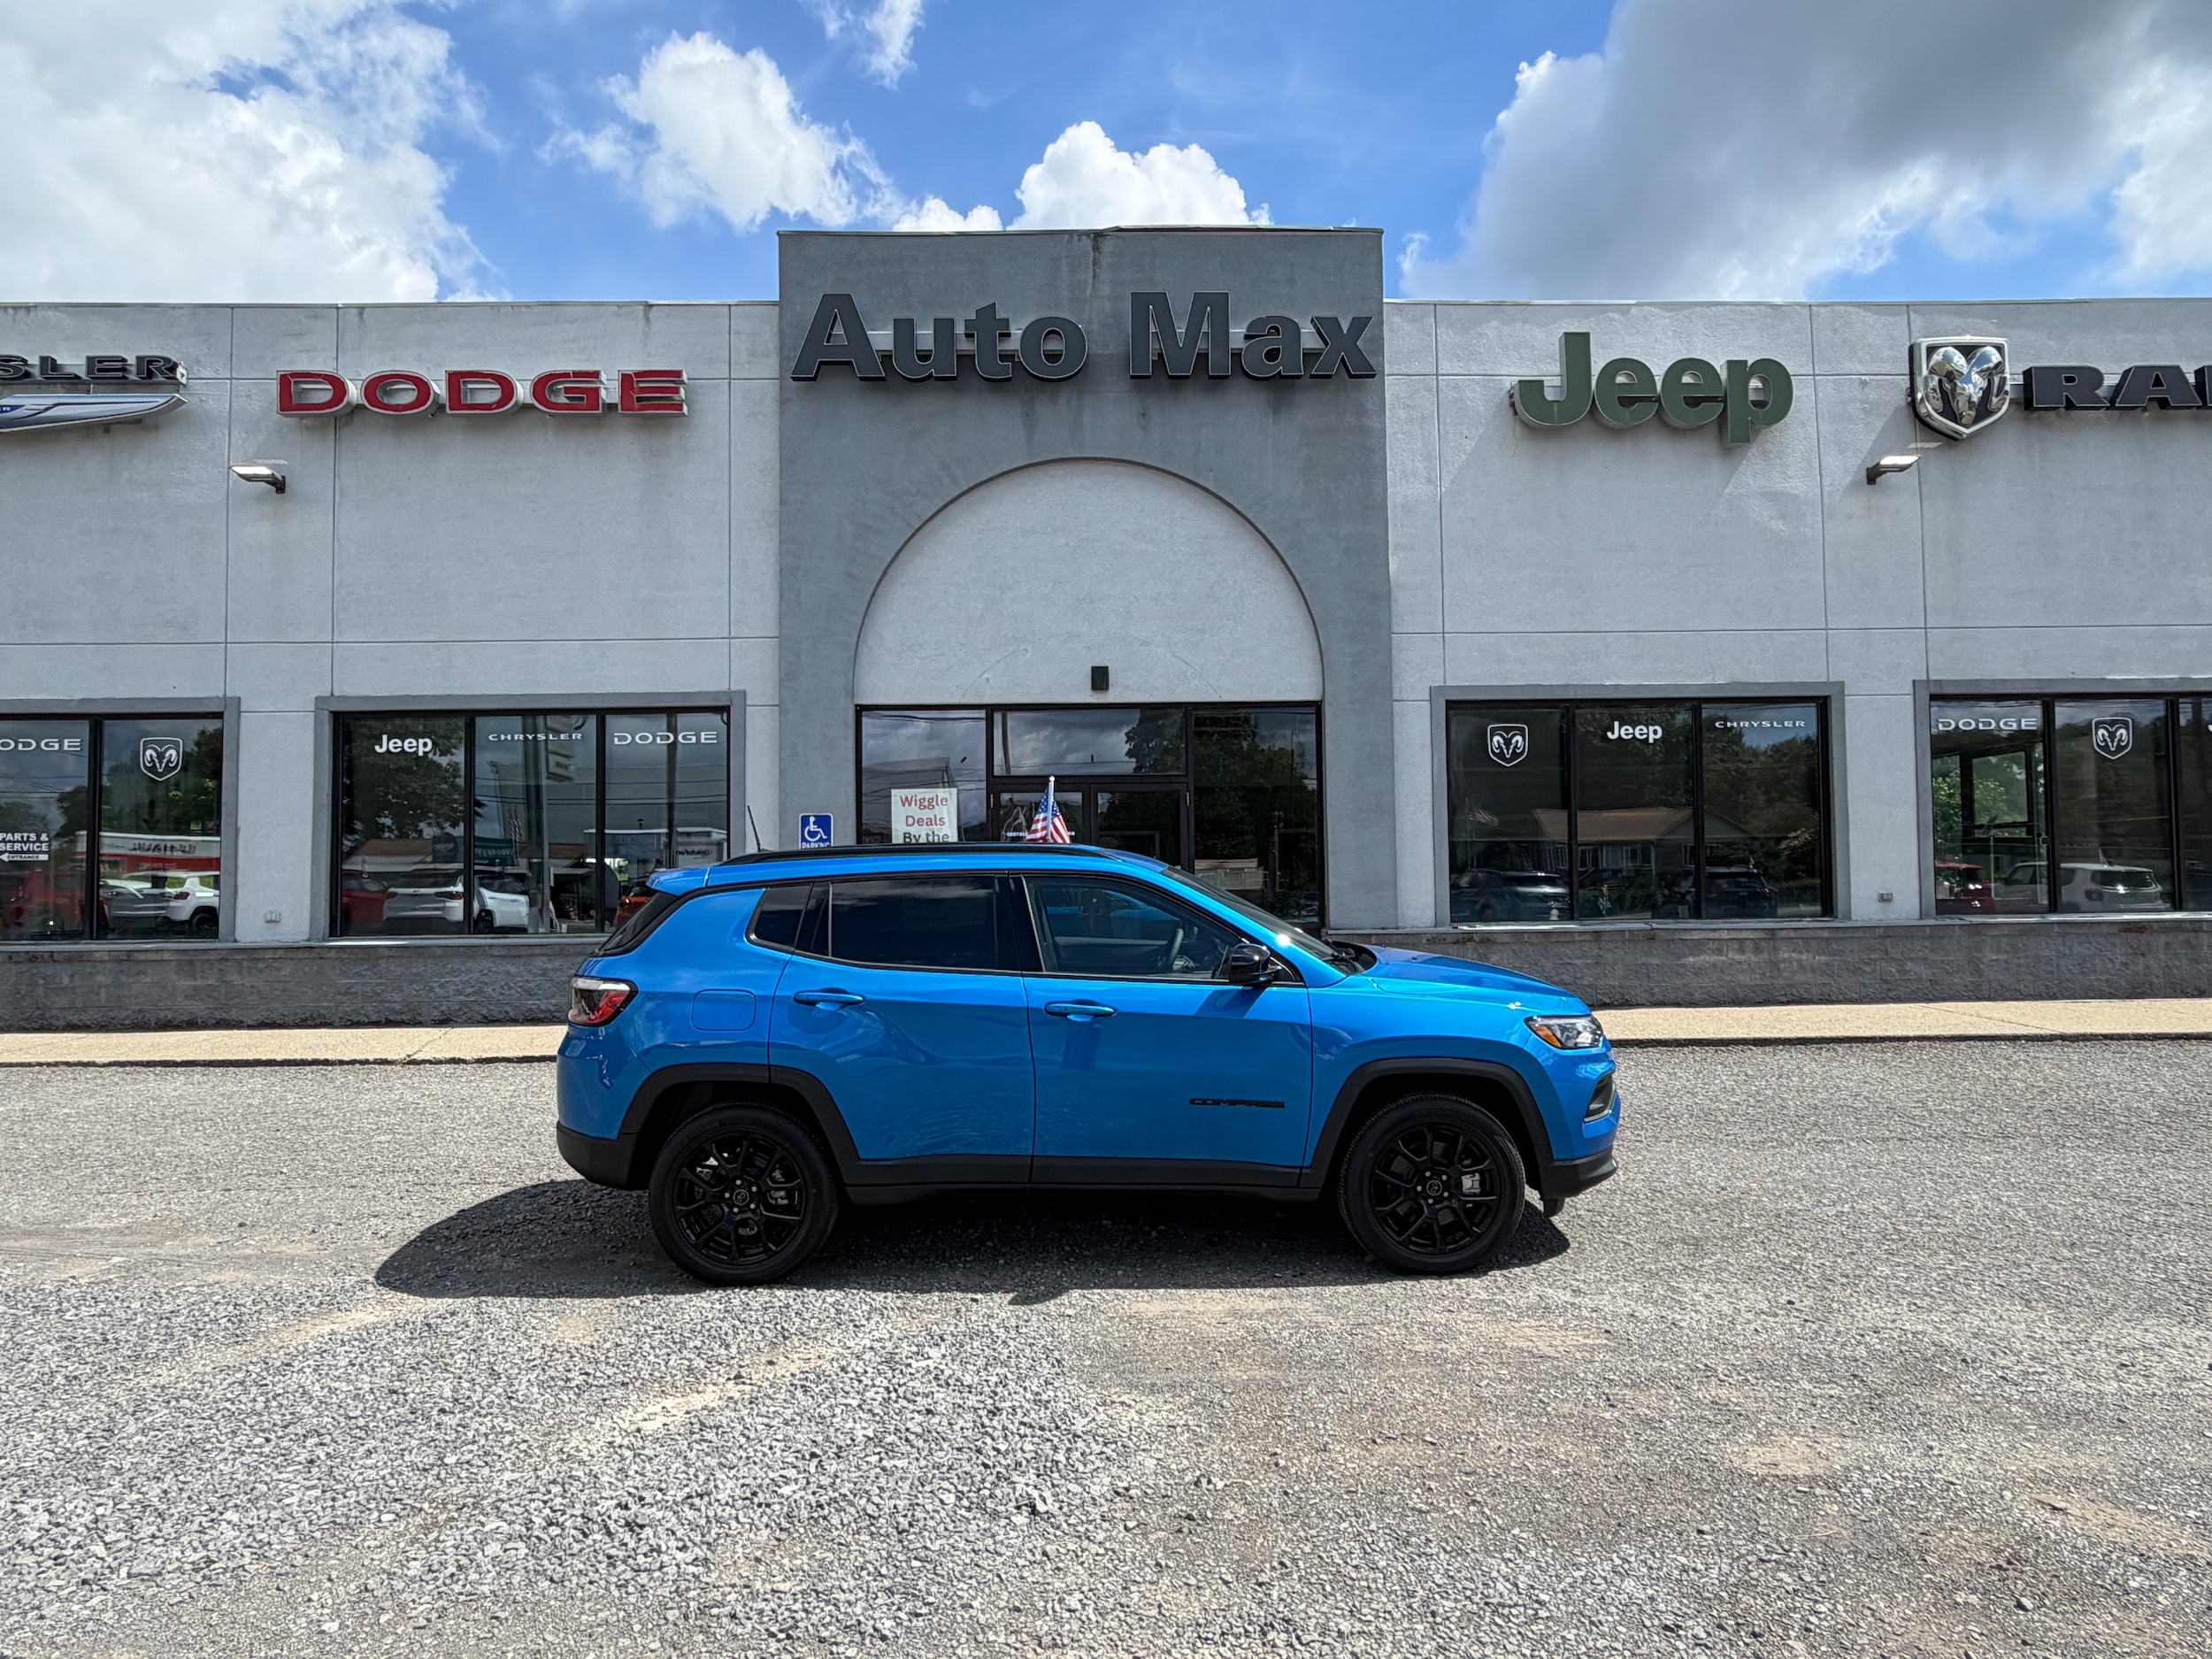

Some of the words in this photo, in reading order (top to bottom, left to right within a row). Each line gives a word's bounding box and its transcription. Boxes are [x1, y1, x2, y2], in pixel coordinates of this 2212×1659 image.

[790, 293, 1088, 381] Auto
[1129, 291, 1377, 380] Max
[276, 369, 688, 418] DODGE
[1513, 332, 1793, 448] Jeep
[2023, 365, 2212, 411] RA
[1715, 719, 1806, 728] CHRYSLER
[1938, 718, 2038, 731] DODGE
[488, 733, 583, 741] CHRYSLER
[614, 731, 718, 745] DODGE
[1607, 720, 1663, 743] Jeep
[374, 734, 433, 757] Jeep
[900, 794, 949, 810] Wiggle
[905, 814, 946, 827] Deals
[0, 833, 37, 841] PARTS
[40, 833, 49, 841] &
[903, 832, 921, 843] By
[926, 831, 949, 843] the
[0, 842, 50, 851] SERVICE
